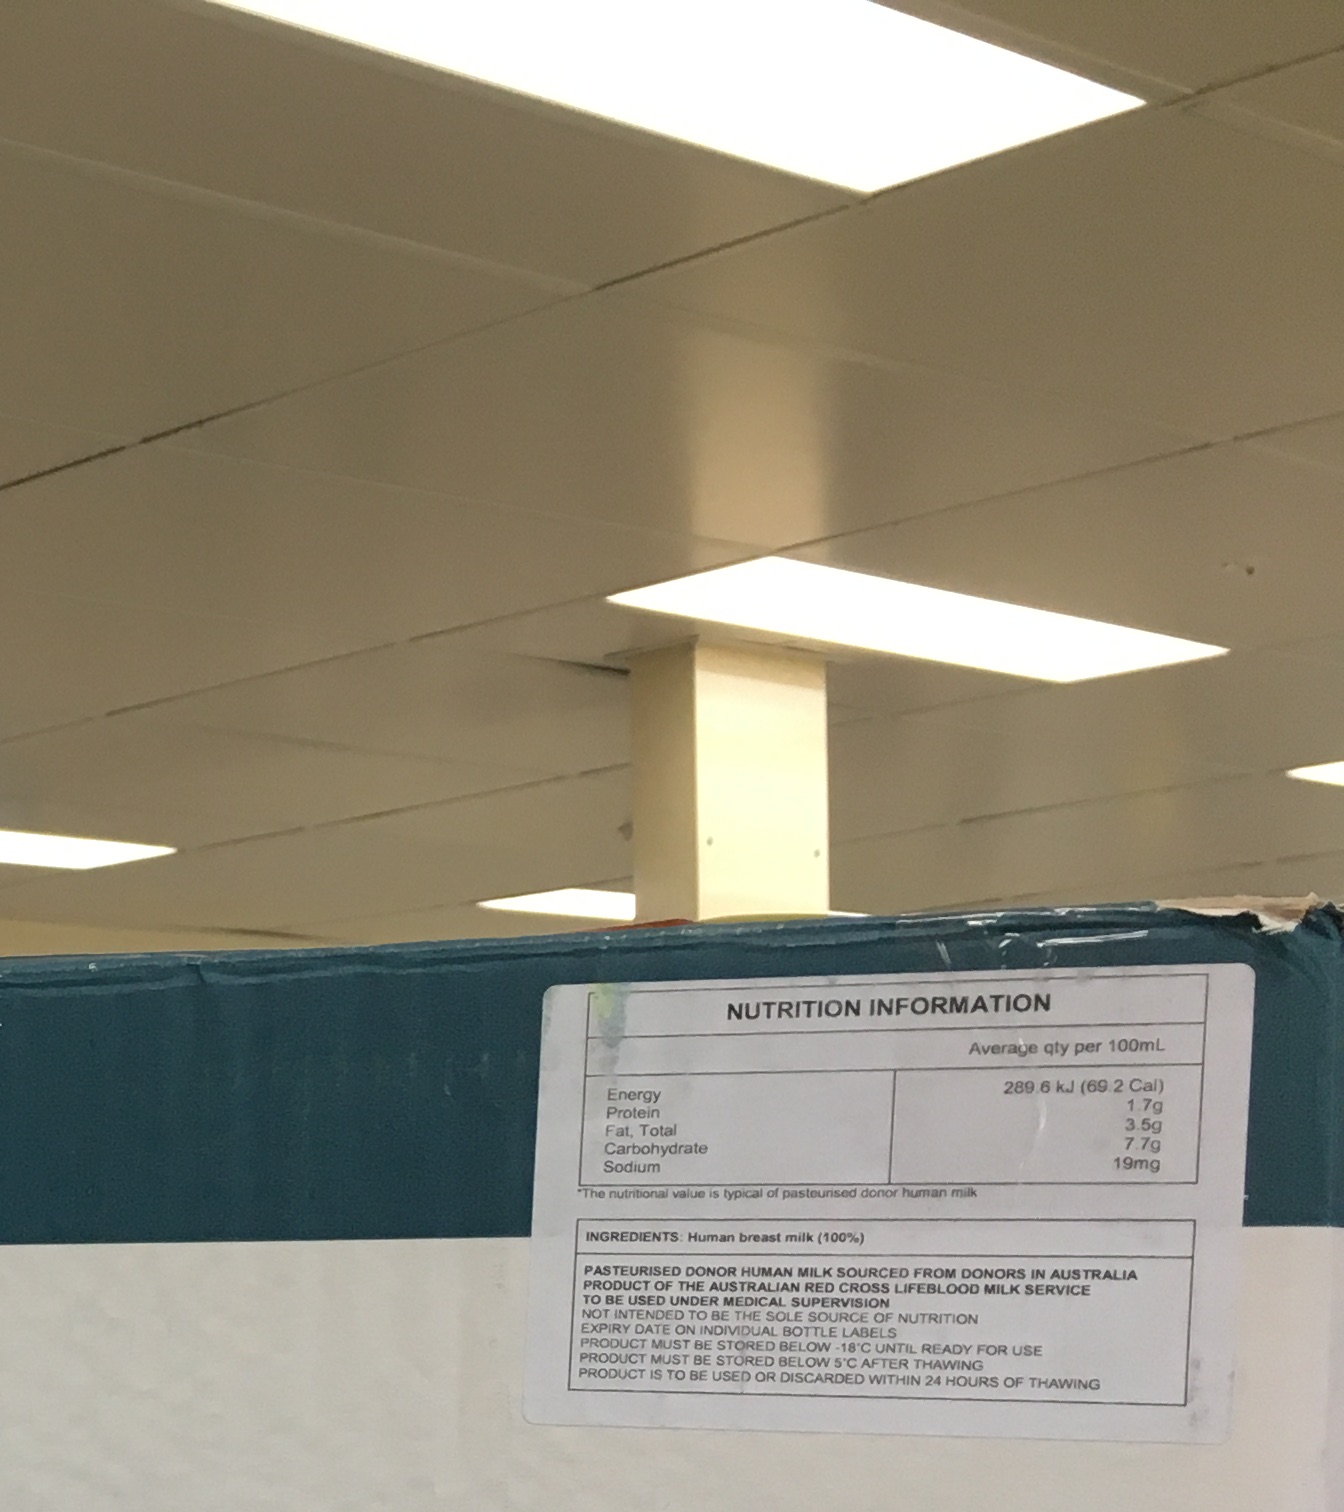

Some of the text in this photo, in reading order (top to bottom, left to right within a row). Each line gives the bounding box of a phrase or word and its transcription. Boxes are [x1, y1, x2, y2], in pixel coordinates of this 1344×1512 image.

[726, 992, 1052, 1021] NUTRITION INFORMATION
[967, 1037, 1166, 1058] Average qty per 100mL
[1054, 1079, 1075, 1095] kJ
[1128, 1077, 1165, 1096] Cal)
[606, 1087, 663, 1105] Energy
[605, 1105, 661, 1120] Protein
[604, 1122, 678, 1140] Fat, Total
[603, 1141, 709, 1159] Carbohydrate
[602, 1159, 661, 1174] Sodium
[1113, 1155, 1161, 1175] 19mg
[608, 1187, 670, 1200] nutritional
[671, 1187, 707, 1200] value
[708, 1189, 721, 1200] is
[723, 1187, 764, 1202] typical
[765, 1186, 781, 1199] of
[781, 1187, 858, 1201] pasteurised
[859, 1187, 900, 1199] donor
[901, 1186, 949, 1199] human
[949, 1186, 979, 1199] milk
[585, 1230, 865, 1247] INGREDIENTS: Human breast milk (100%)
[583, 1264, 1139, 1282] PASTEURISED DONOR HUMAN MILK SOURCED FROM DONORS IN AUSTRALIA
[582, 1279, 1092, 1297] PRODUCT OF THE AUSTRALIAN RED CROSS LIFEBLOOD MILK SERVICE
[582, 1293, 891, 1310] TO BE USED UNDER MEDICAL SUPERVISION
[581, 1307, 979, 1326] NOT INTENDED TO BE THE SOLE SOURCE OF NUTRITION
[580, 1321, 898, 1340] EXPIRY DATE ON INDIVIDUAL BOTTLE LABELS
[579, 1336, 649, 1351] PRODUCT
[650, 1338, 692, 1351] MUST
[693, 1339, 714, 1352] BE
[716, 1339, 777, 1355] STORED
[778, 1340, 833, 1354] BELOW
[874, 1342, 918, 1355] UNTIL
[920, 1342, 974, 1356] READY
[976, 1343, 1009, 1357] FOR
[1011, 1343, 1043, 1358] USE
[578, 1351, 648, 1366] PRODUCT
[649, 1353, 691, 1366] MUST
[692, 1353, 712, 1367] BE
[715, 1353, 776, 1368] STORED
[777, 1355, 832, 1369] BELOW
[859, 1357, 910, 1371] AFTER
[913, 1358, 985, 1372] THAWING
[577, 1366, 1101, 1392] PRODUCT IS TO BE USED OR DISCARDED WITHIN 24 HOURS OF THAWING
